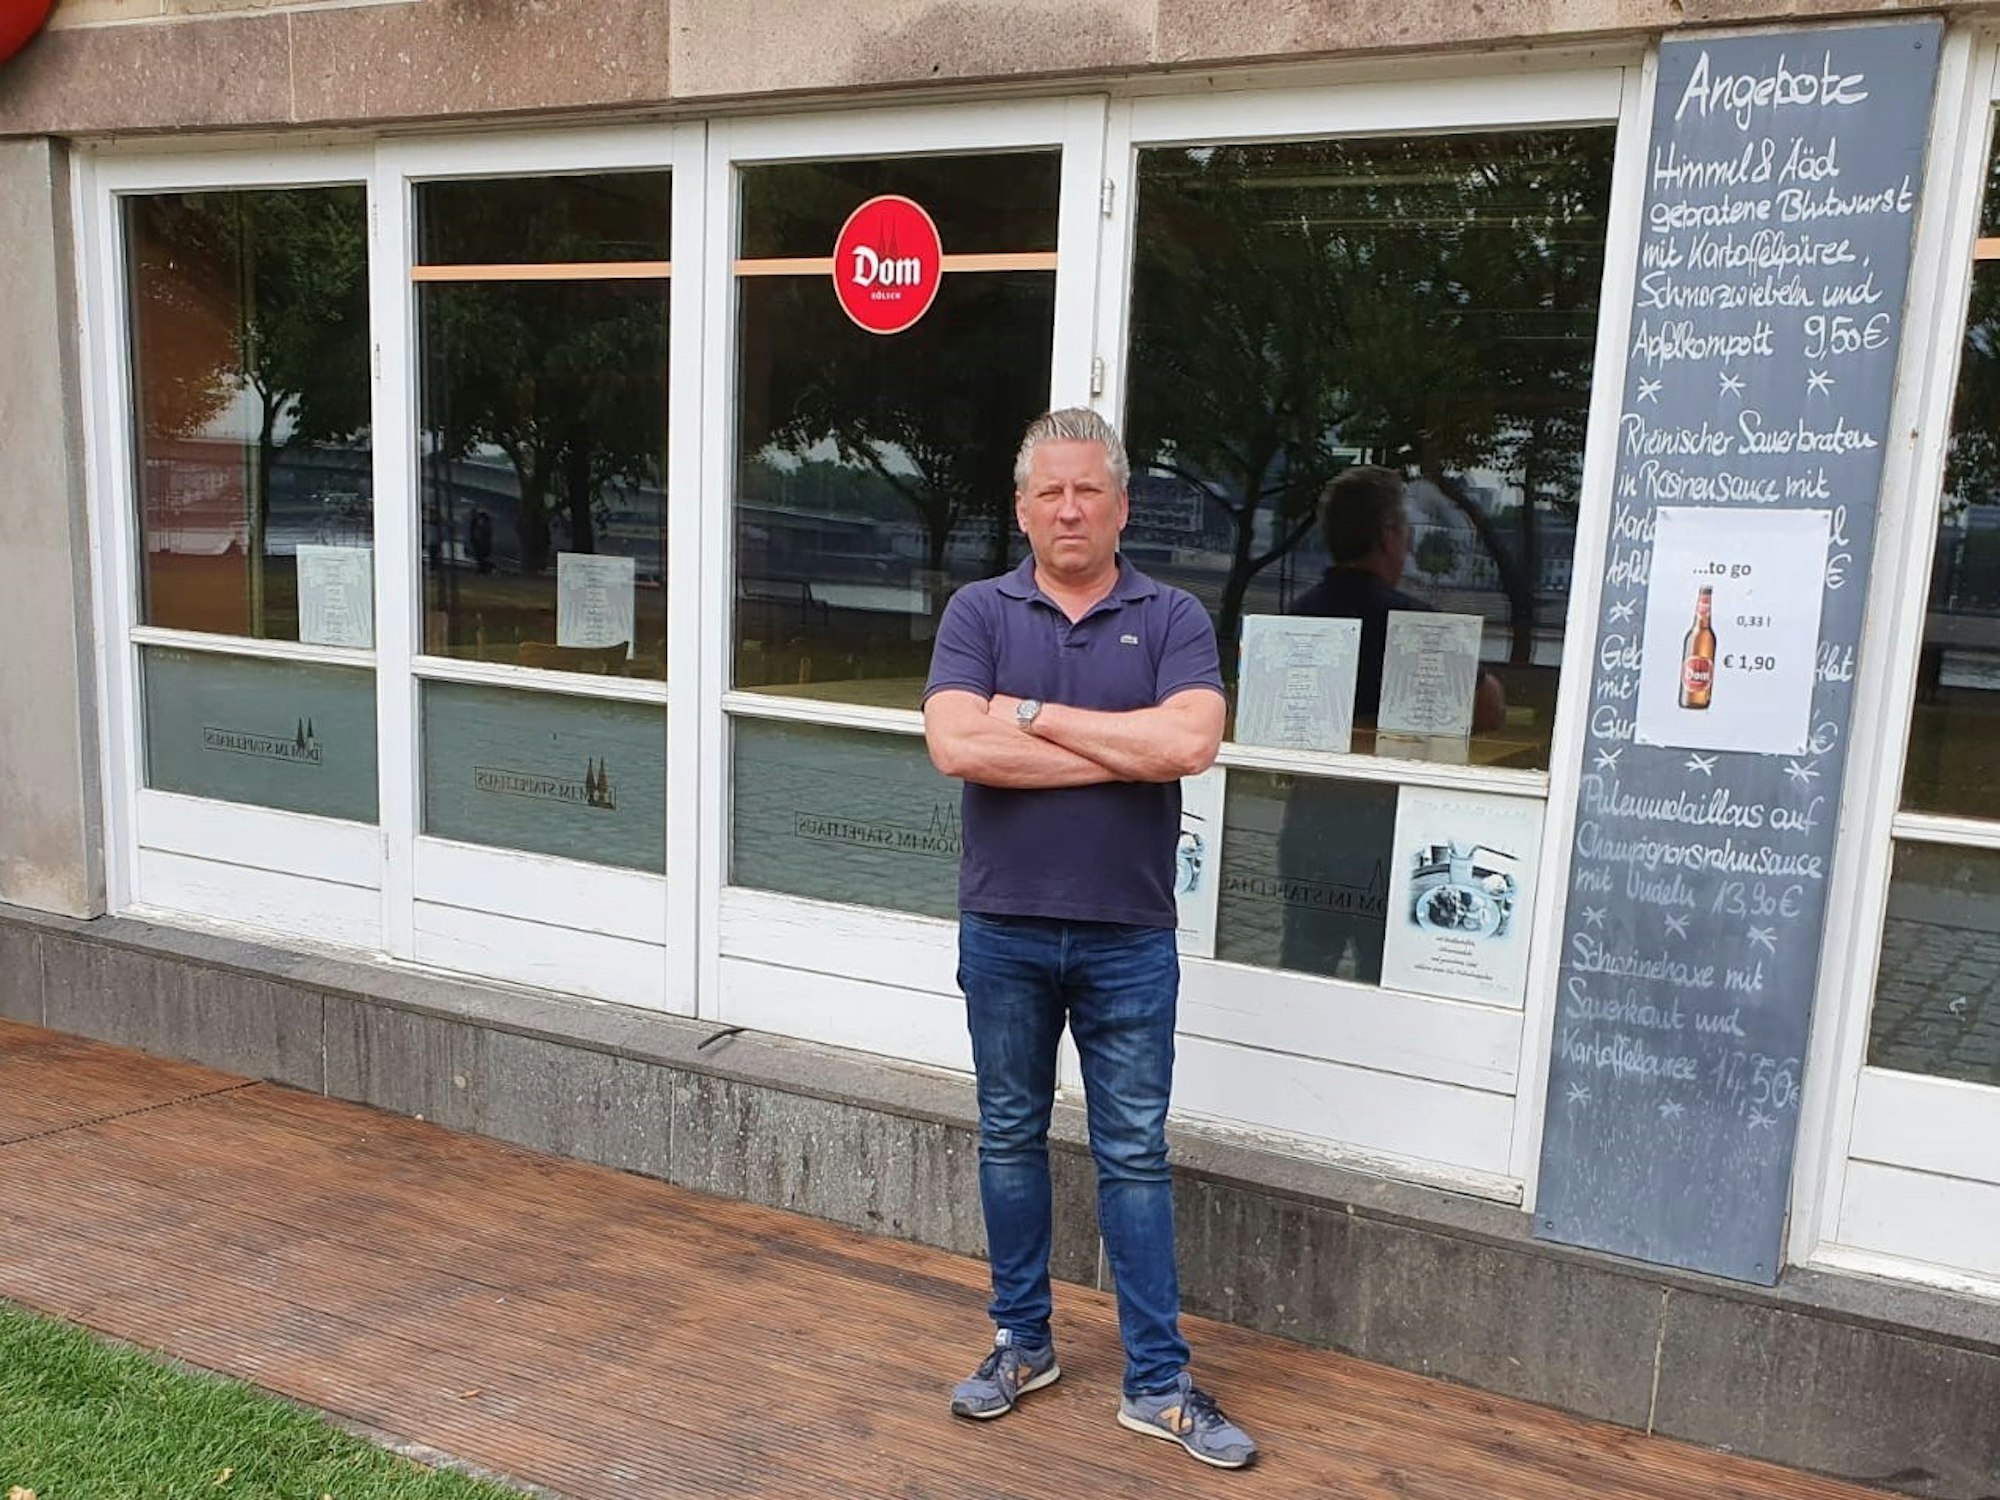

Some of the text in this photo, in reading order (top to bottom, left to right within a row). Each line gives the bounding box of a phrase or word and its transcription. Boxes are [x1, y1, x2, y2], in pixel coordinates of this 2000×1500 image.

[1675, 50, 1868, 130] Angebote
[1650, 175, 1913, 233] gebratene Blutwurst
[852, 245, 921, 287] Dom
[1642, 236, 1683, 269] mit
[1637, 271, 1883, 309] Schmorzwiebeln und
[1631, 313, 1890, 370] Apfelkompott 9,50€
[1620, 409, 1878, 458] Rheinischer Sauerbraten
[1618, 466, 1638, 497] in
[1785, 466, 1831, 500] mit
[1730, 563, 1752, 579] go
[1736, 615, 1764, 628] 0,33
[1723, 653, 1776, 672] € 1,90
[1770, 795, 1825, 837] auf
[1574, 866, 1615, 893] mit
[1572, 932, 1764, 992] Schweinehaxe mit
[1566, 977, 1746, 1038] Sauerkraut und
